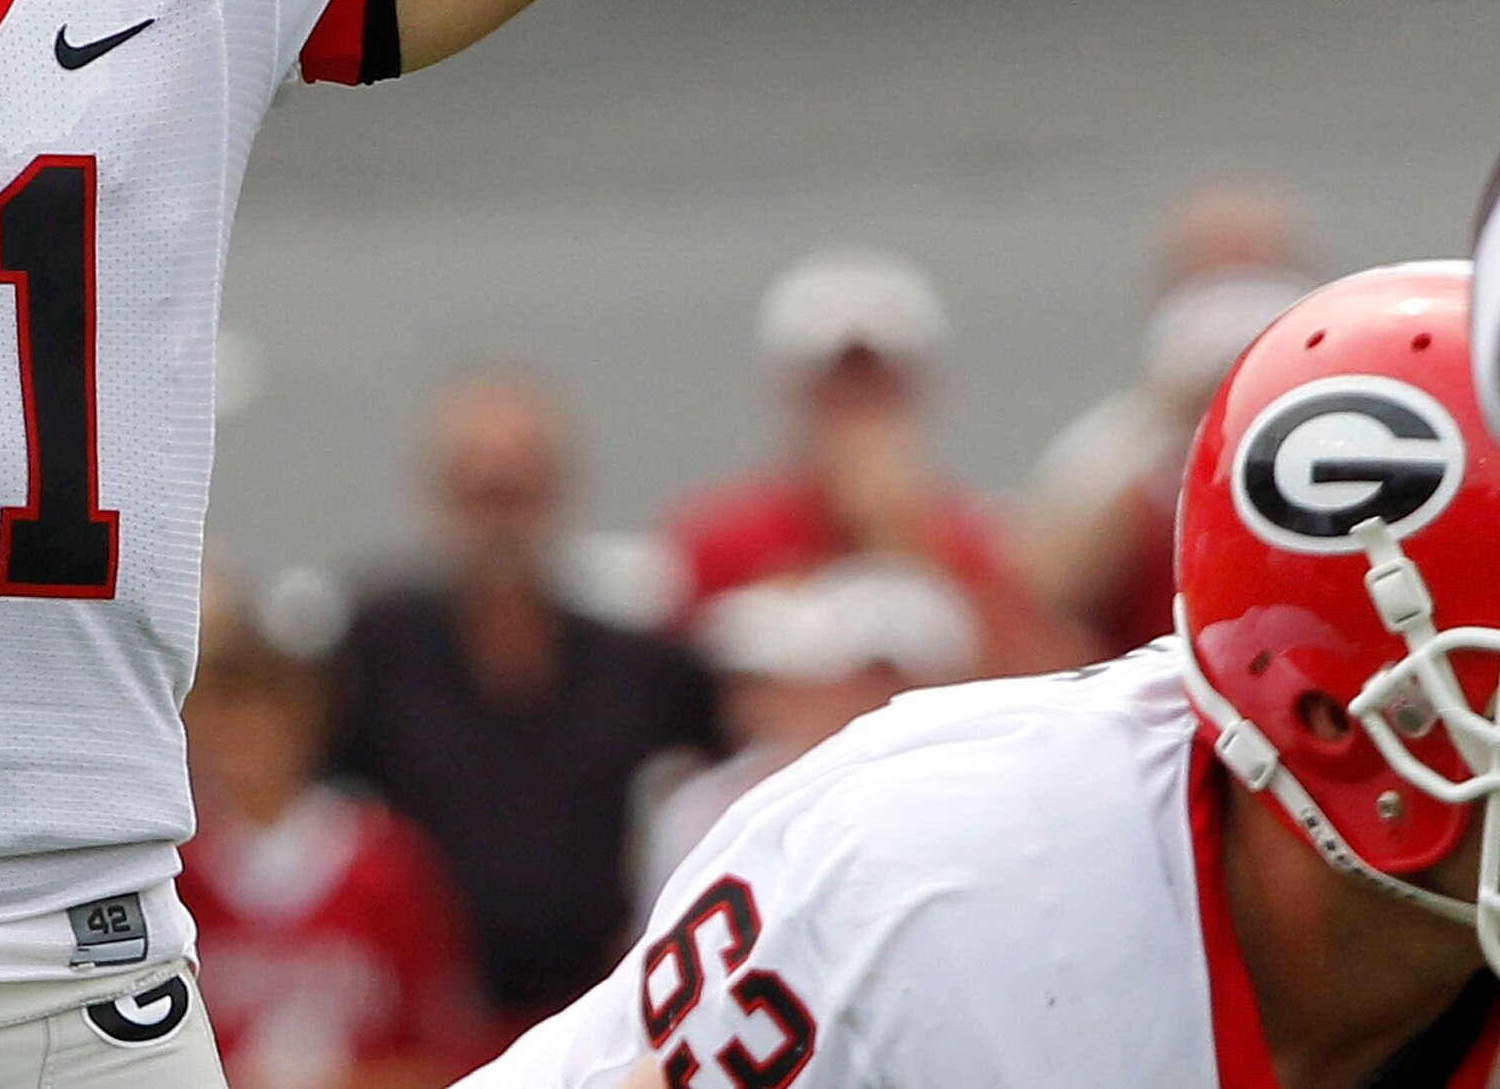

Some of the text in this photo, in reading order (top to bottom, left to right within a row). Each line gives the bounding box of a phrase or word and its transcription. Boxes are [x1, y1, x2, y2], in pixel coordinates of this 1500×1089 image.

[1235, 380, 1458, 548] G
[87, 904, 131, 935] 42
[642, 873, 817, 1089] 63
